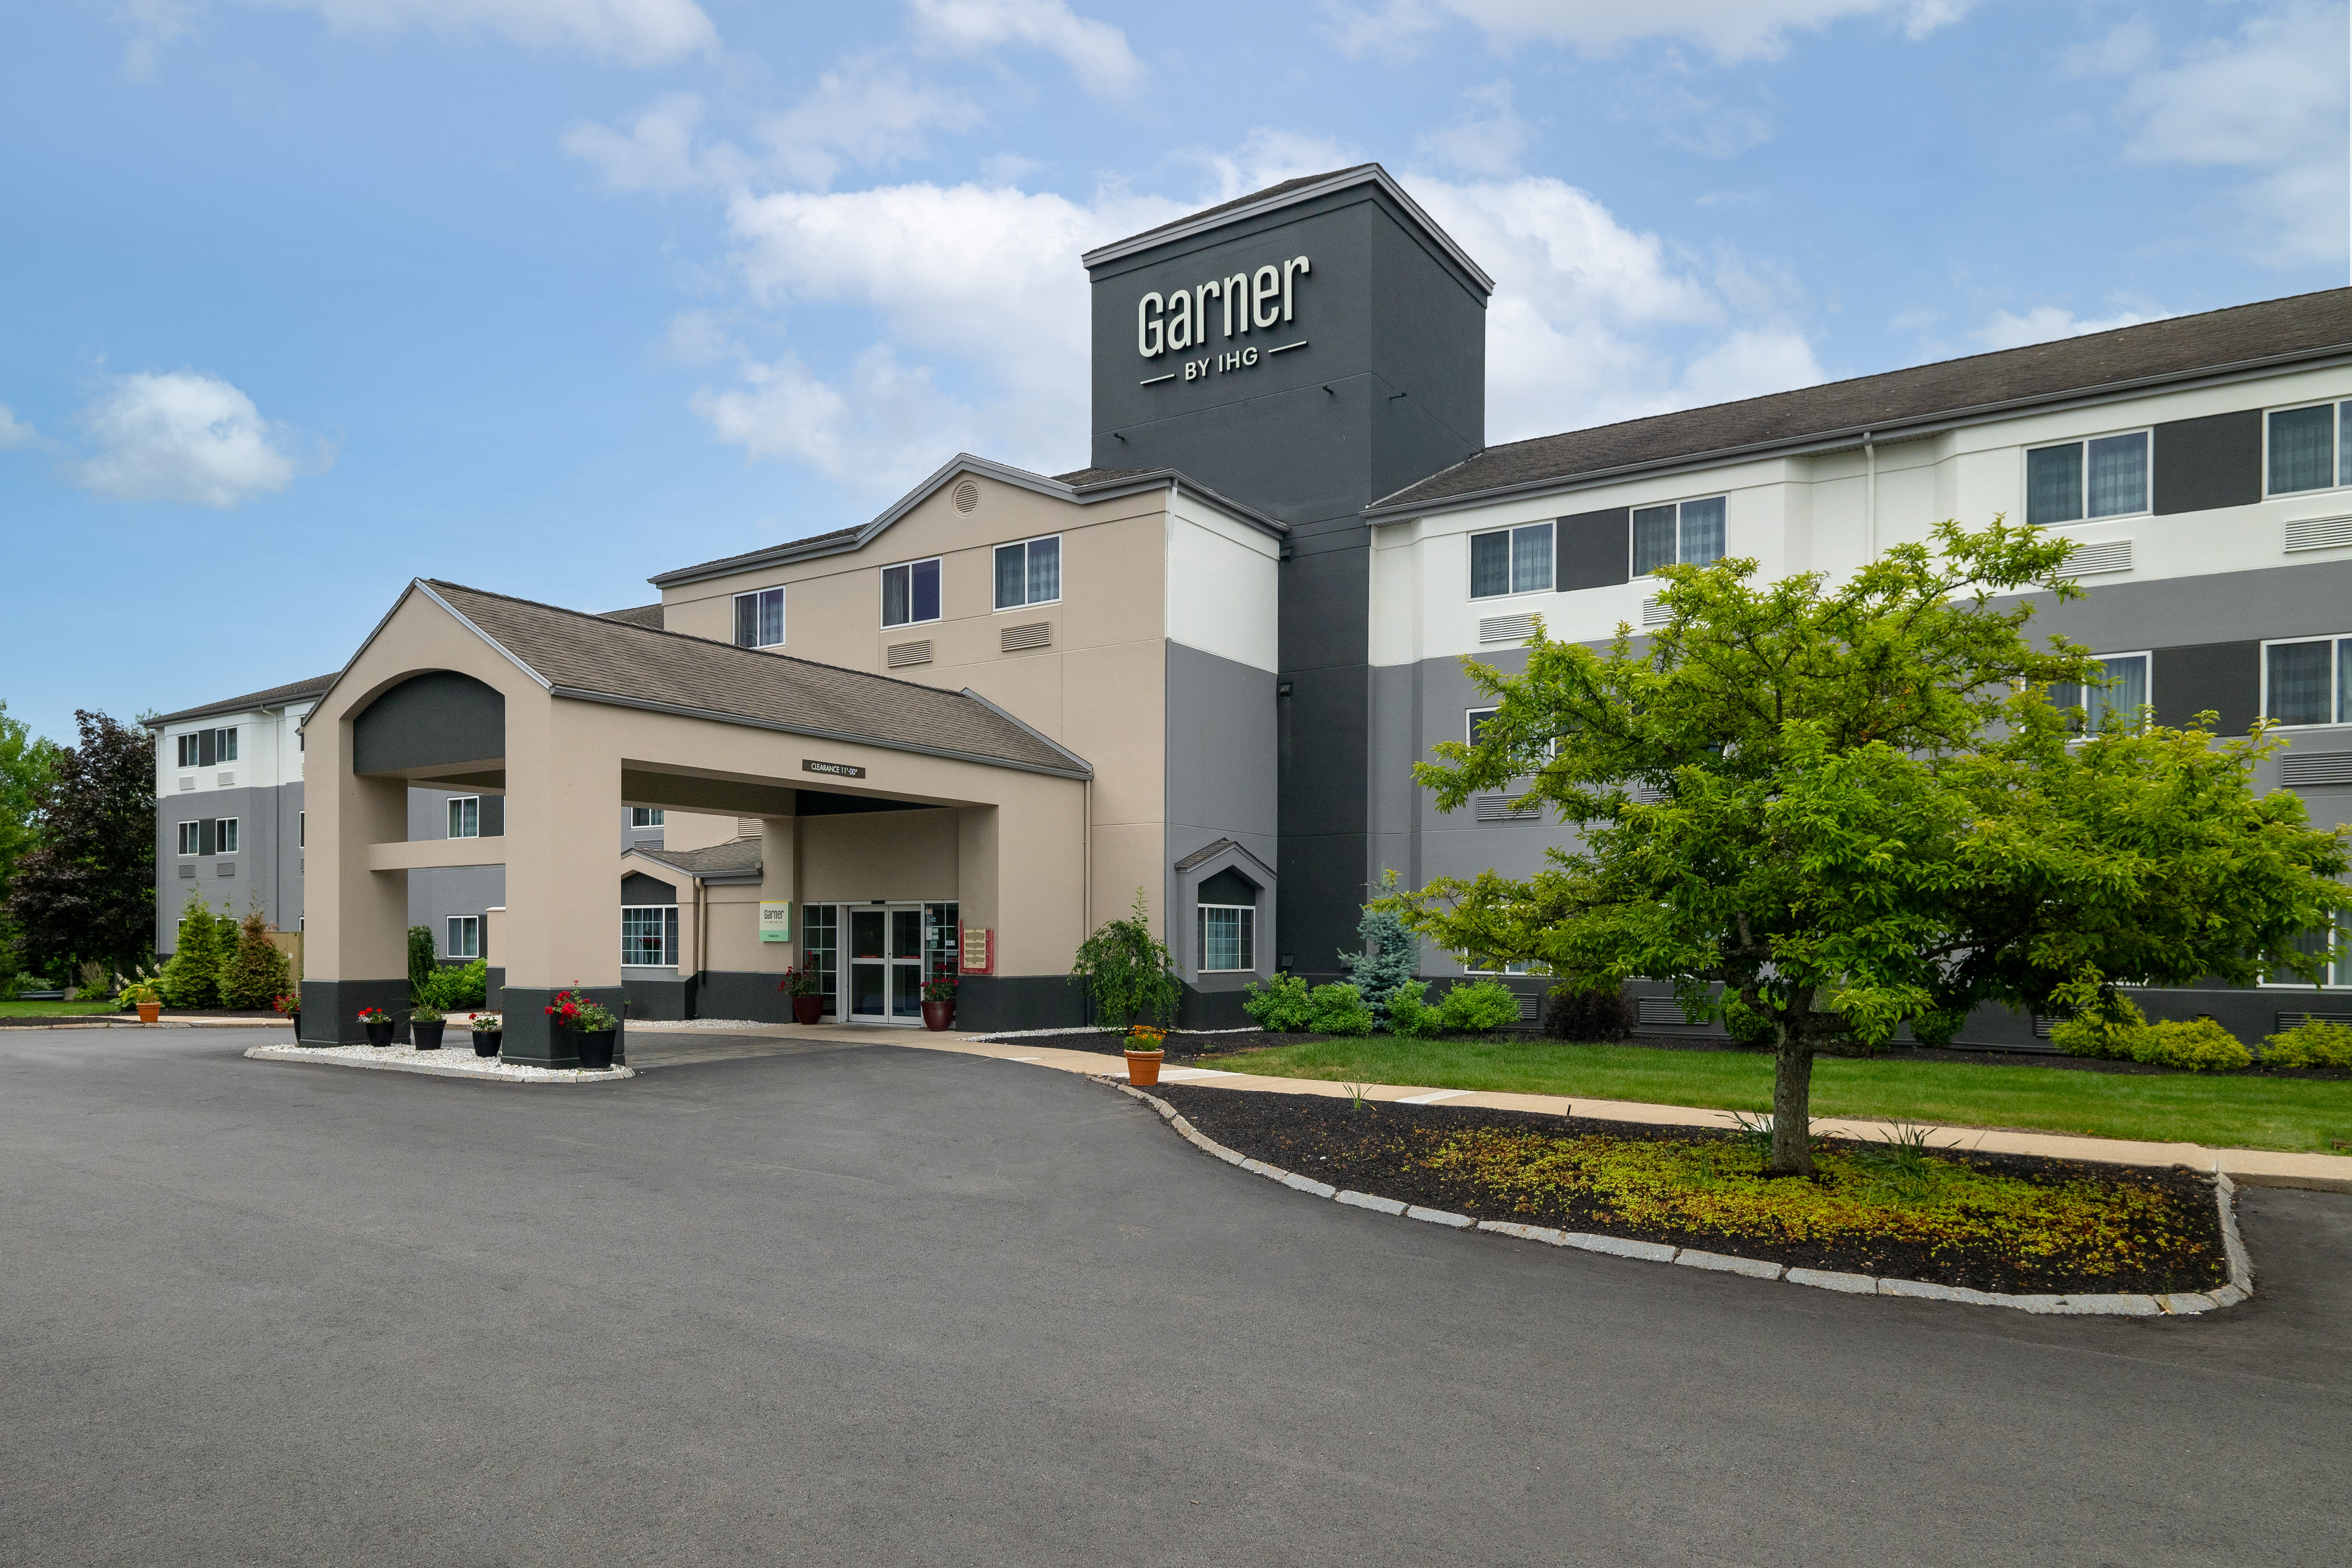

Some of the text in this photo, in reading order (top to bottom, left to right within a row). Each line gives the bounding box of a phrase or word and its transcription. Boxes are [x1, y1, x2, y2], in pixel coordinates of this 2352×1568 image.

[1138, 256, 1310, 358] Garner
[1185, 347, 1258, 380] BY IHG
[811, 763, 839, 773] CLEARANCE
[764, 910, 784, 919] Garner
